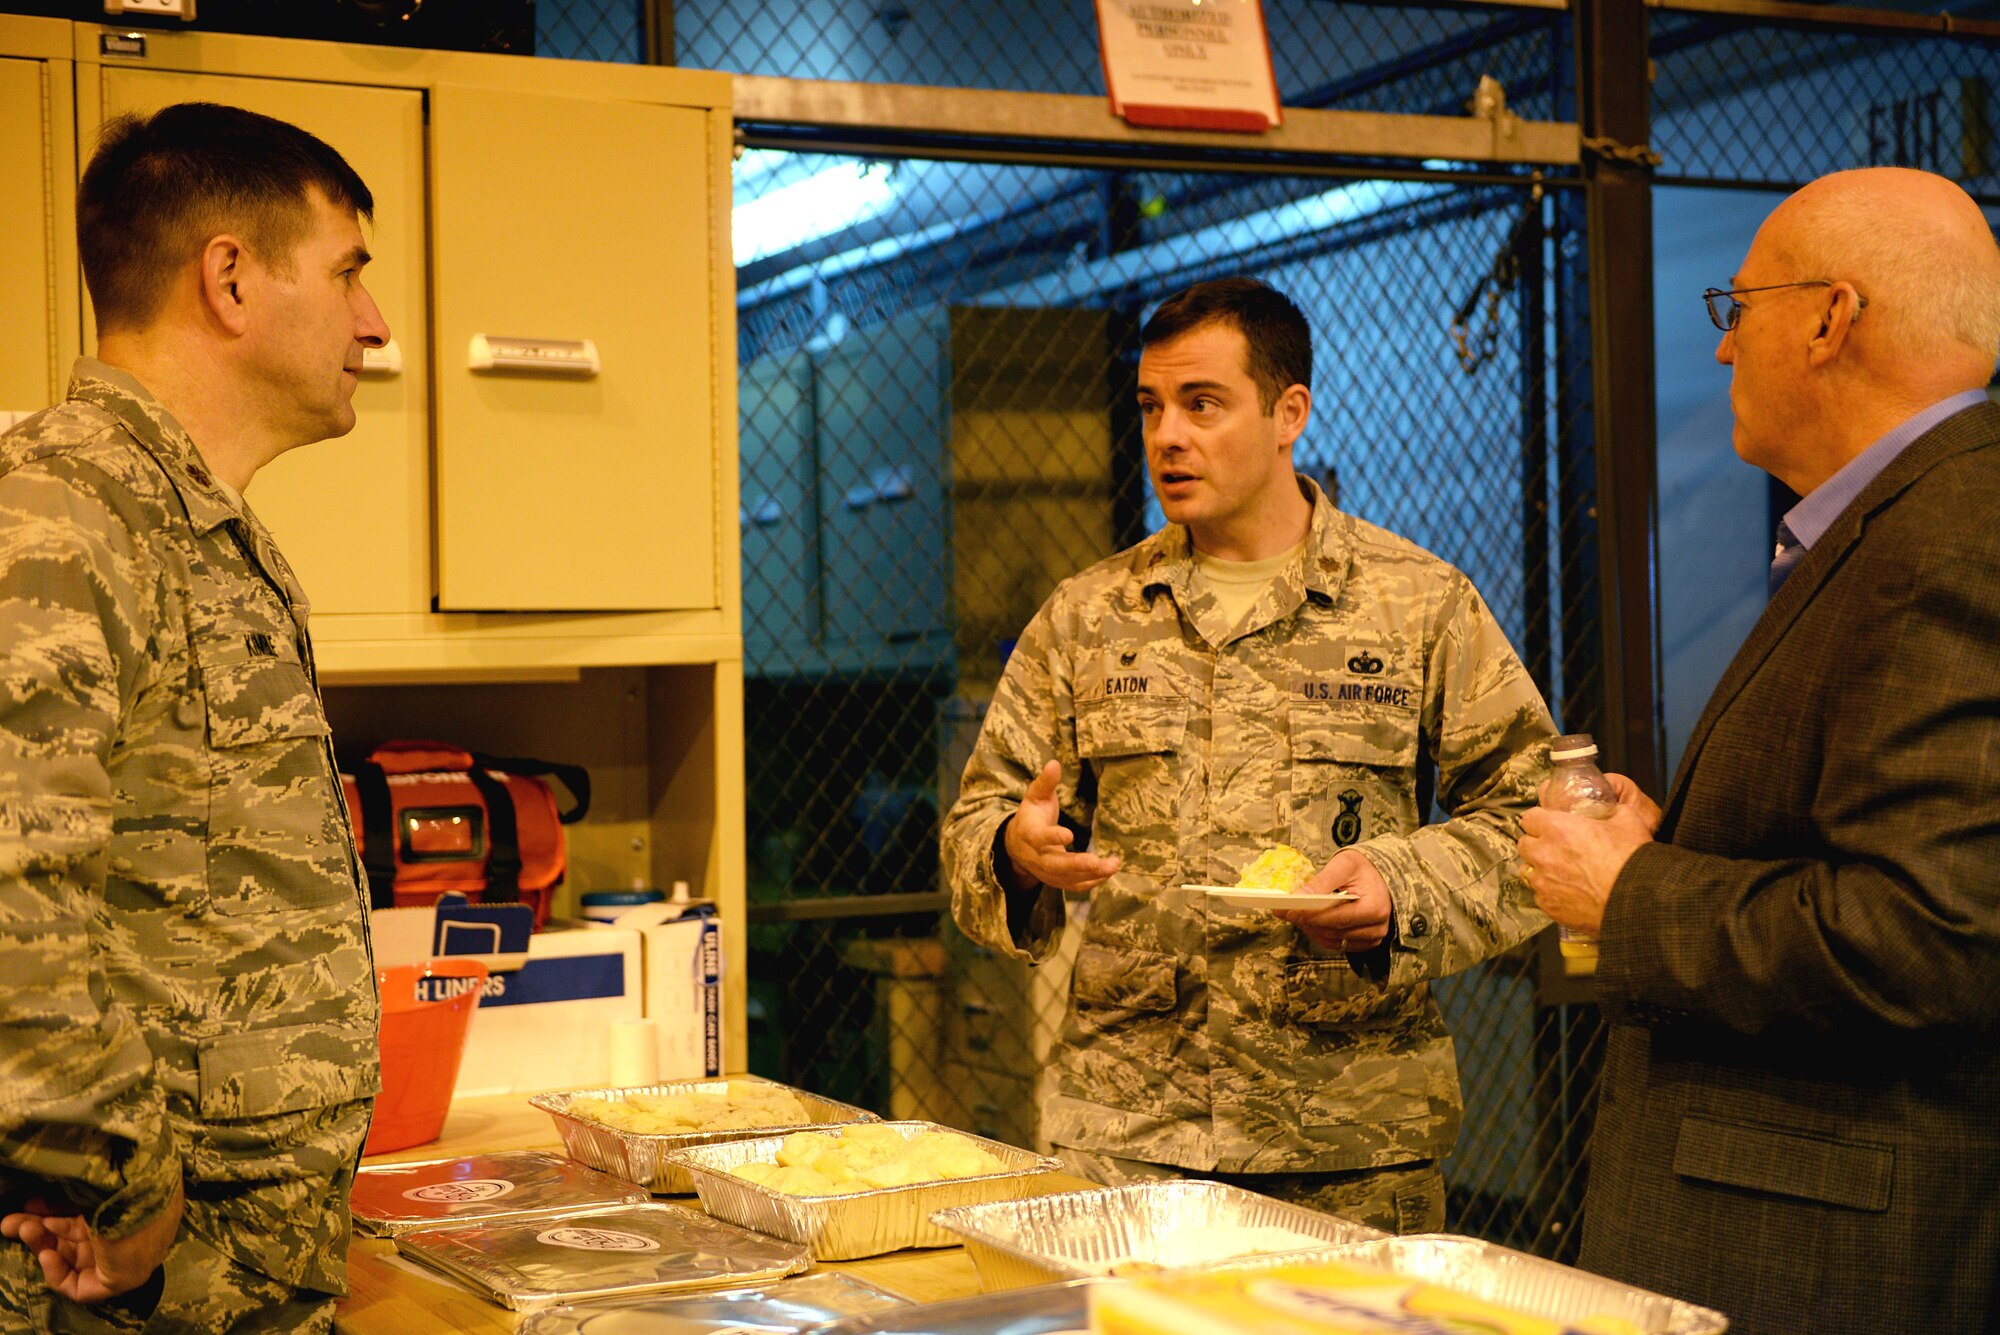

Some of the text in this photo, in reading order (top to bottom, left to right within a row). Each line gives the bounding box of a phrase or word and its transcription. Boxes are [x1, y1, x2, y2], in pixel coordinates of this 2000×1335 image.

[1106, 676, 1148, 694] EATON
[1304, 682, 1410, 706] U.S. AIR FORCE
